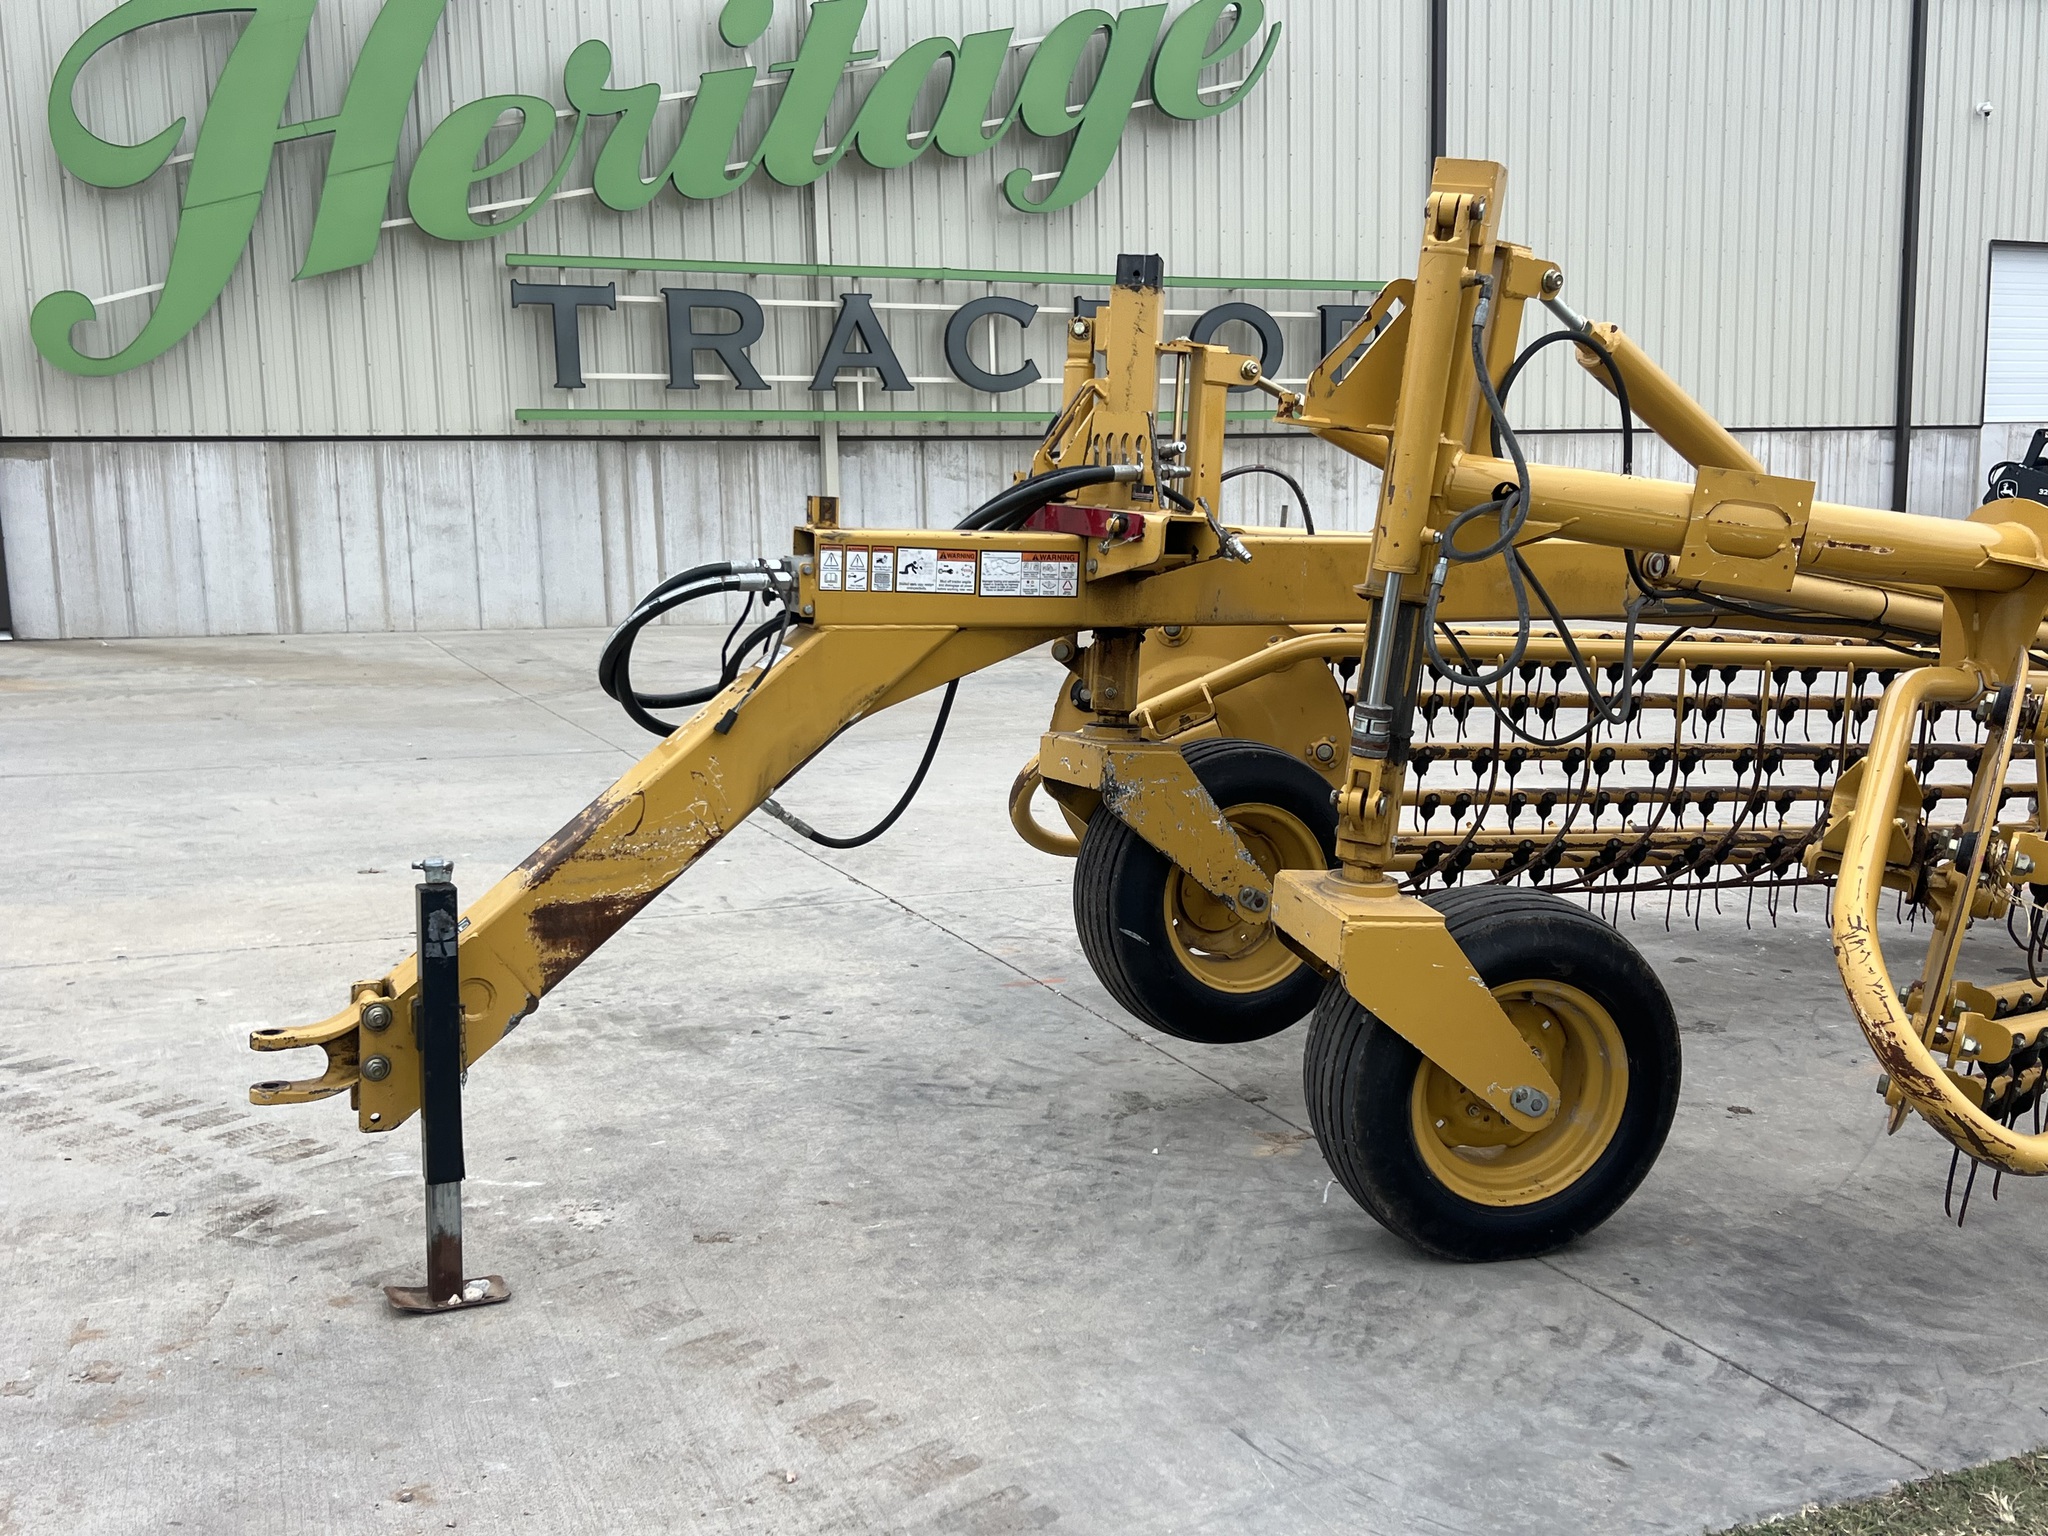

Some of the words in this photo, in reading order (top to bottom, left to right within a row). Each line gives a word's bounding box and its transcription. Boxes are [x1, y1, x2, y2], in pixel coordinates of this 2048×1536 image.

[30, 0, 1281, 377] Heritage
[510, 277, 1393, 393] TRACO
[2038, 488, 2048, 496] 32
[947, 552, 975, 560] WARNING
[1039, 554, 1075, 562] WARNING
